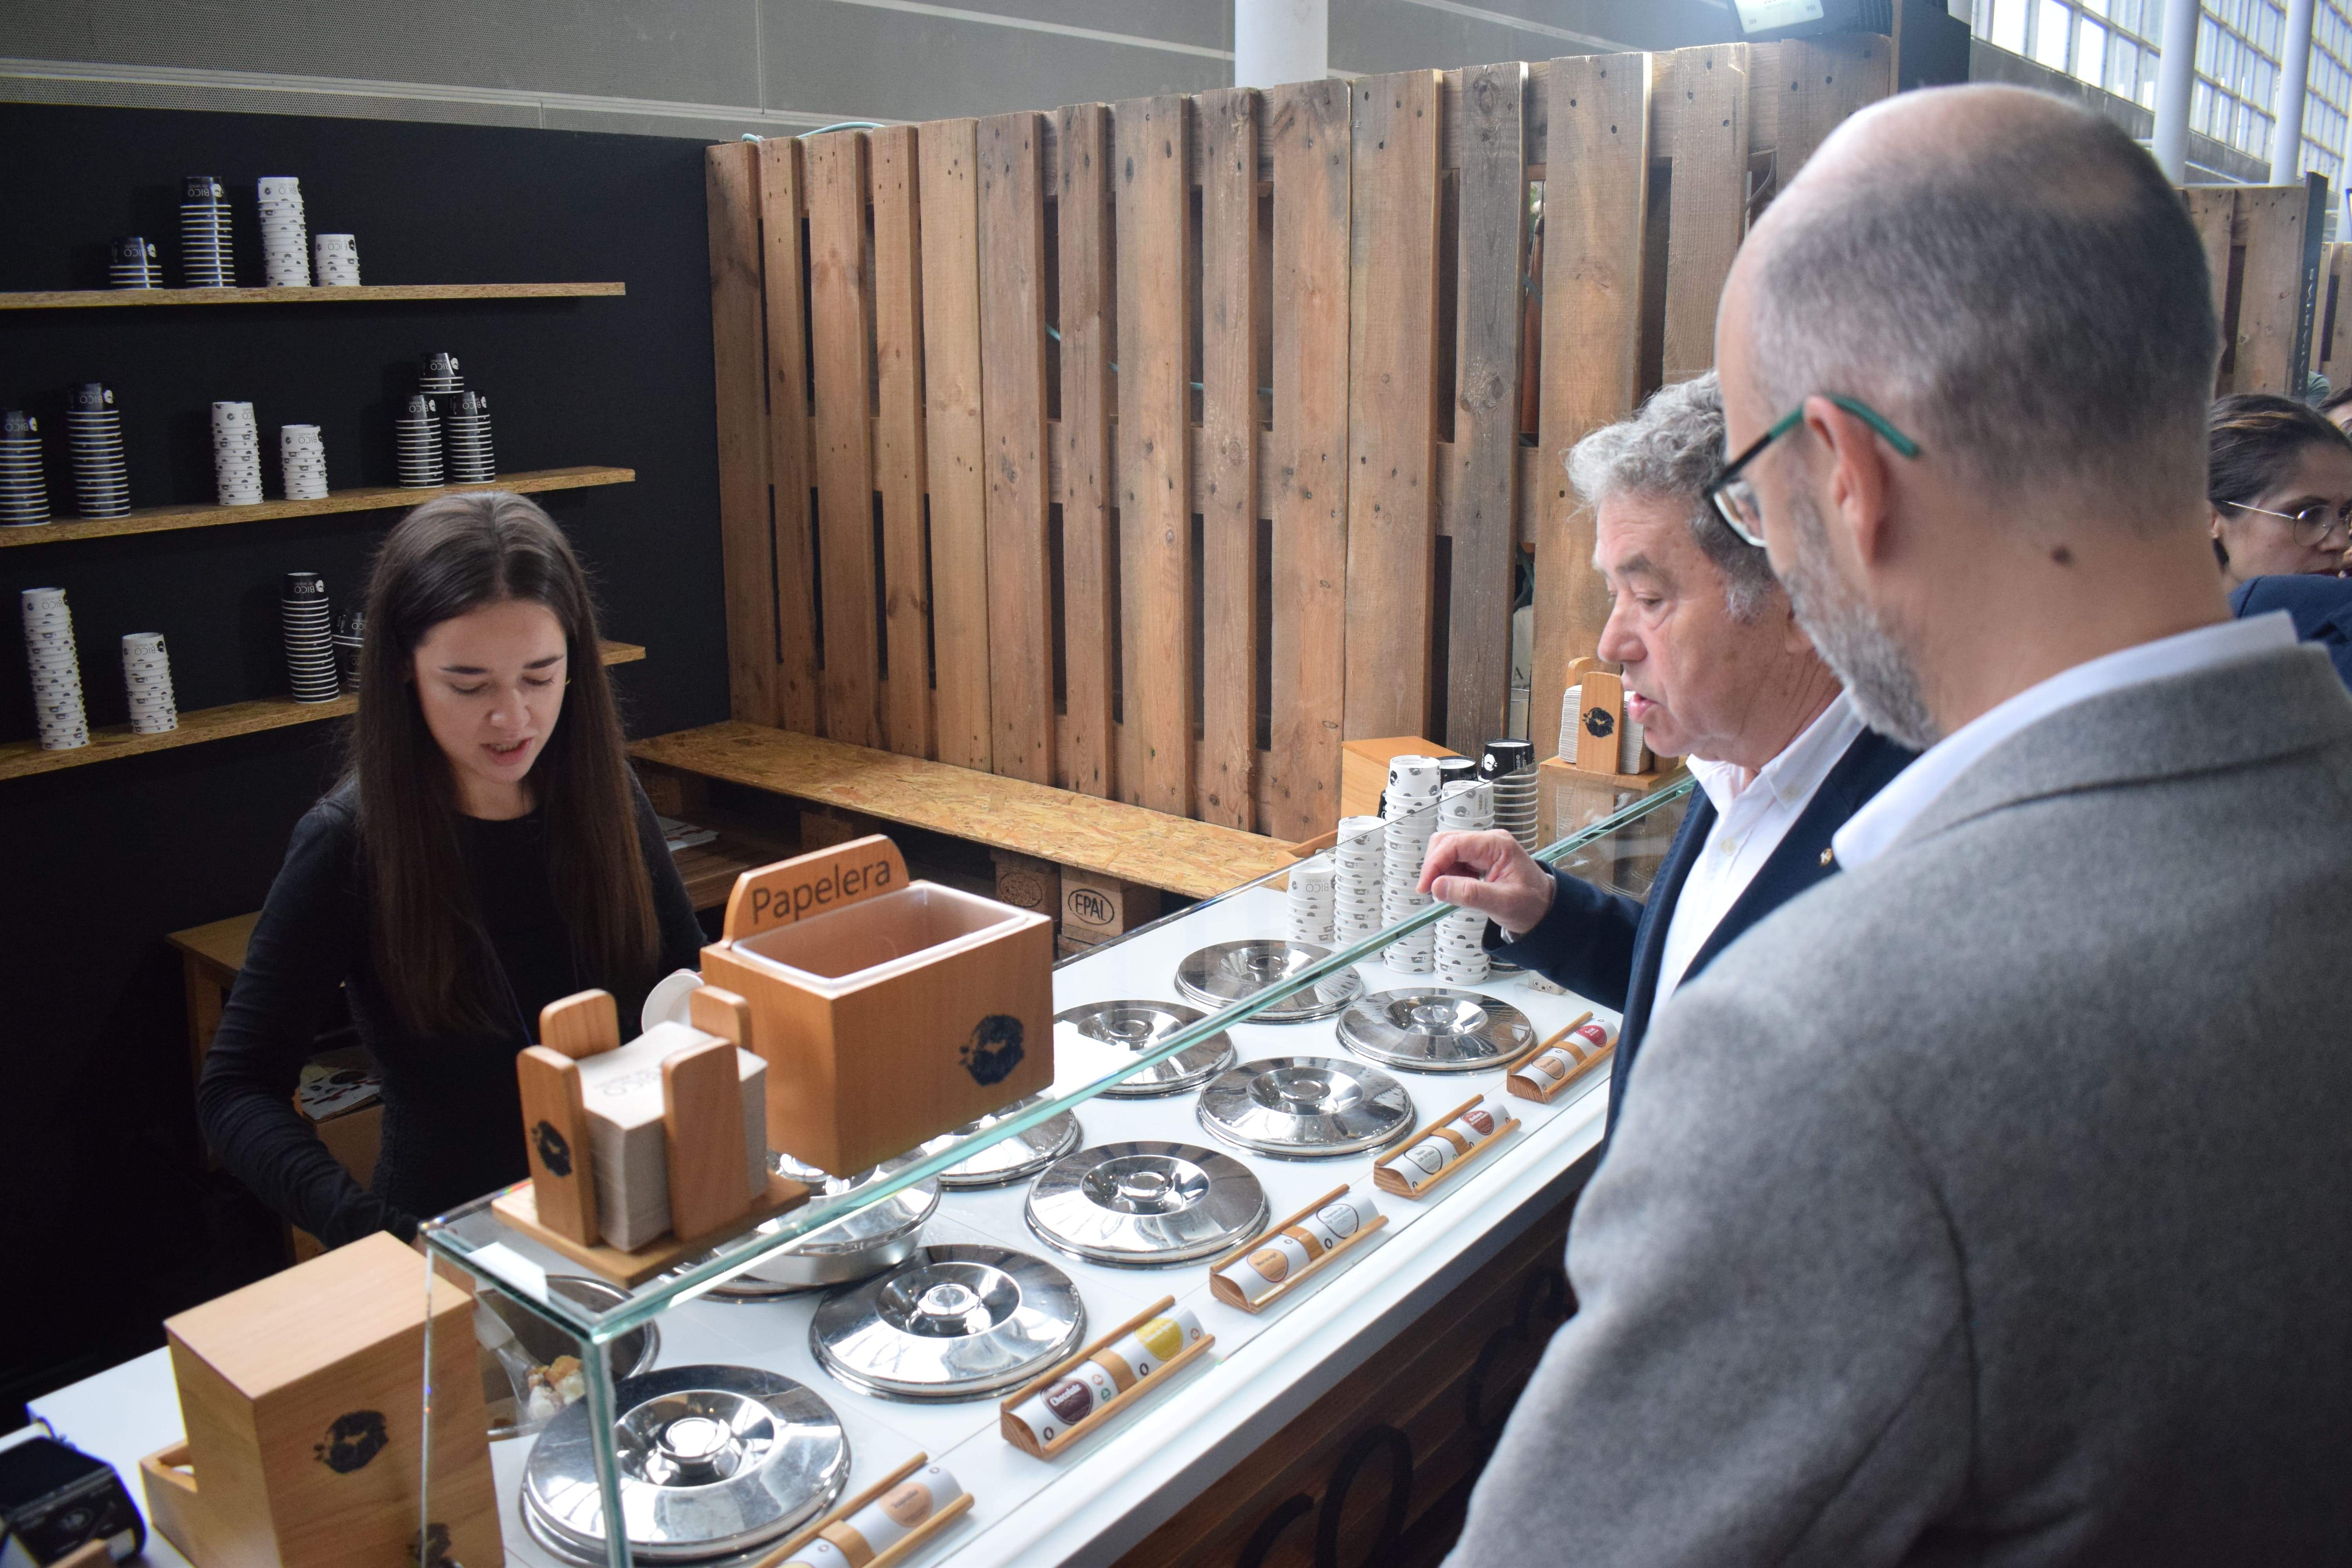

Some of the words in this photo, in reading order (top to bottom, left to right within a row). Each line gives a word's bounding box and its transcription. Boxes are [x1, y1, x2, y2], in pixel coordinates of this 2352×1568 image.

[188, 189, 209, 197] BICO
[124, 249, 142, 257] ICO
[80, 396, 103, 404] BICO
[5, 423, 29, 431] BICO
[135, 646, 156, 655] BICO
[752, 860, 890, 924] Papelera
[1305, 883, 1328, 892] BICO
[1075, 893, 1106, 921] EPAL
[1050, 1384, 1081, 1406] Chocolate
